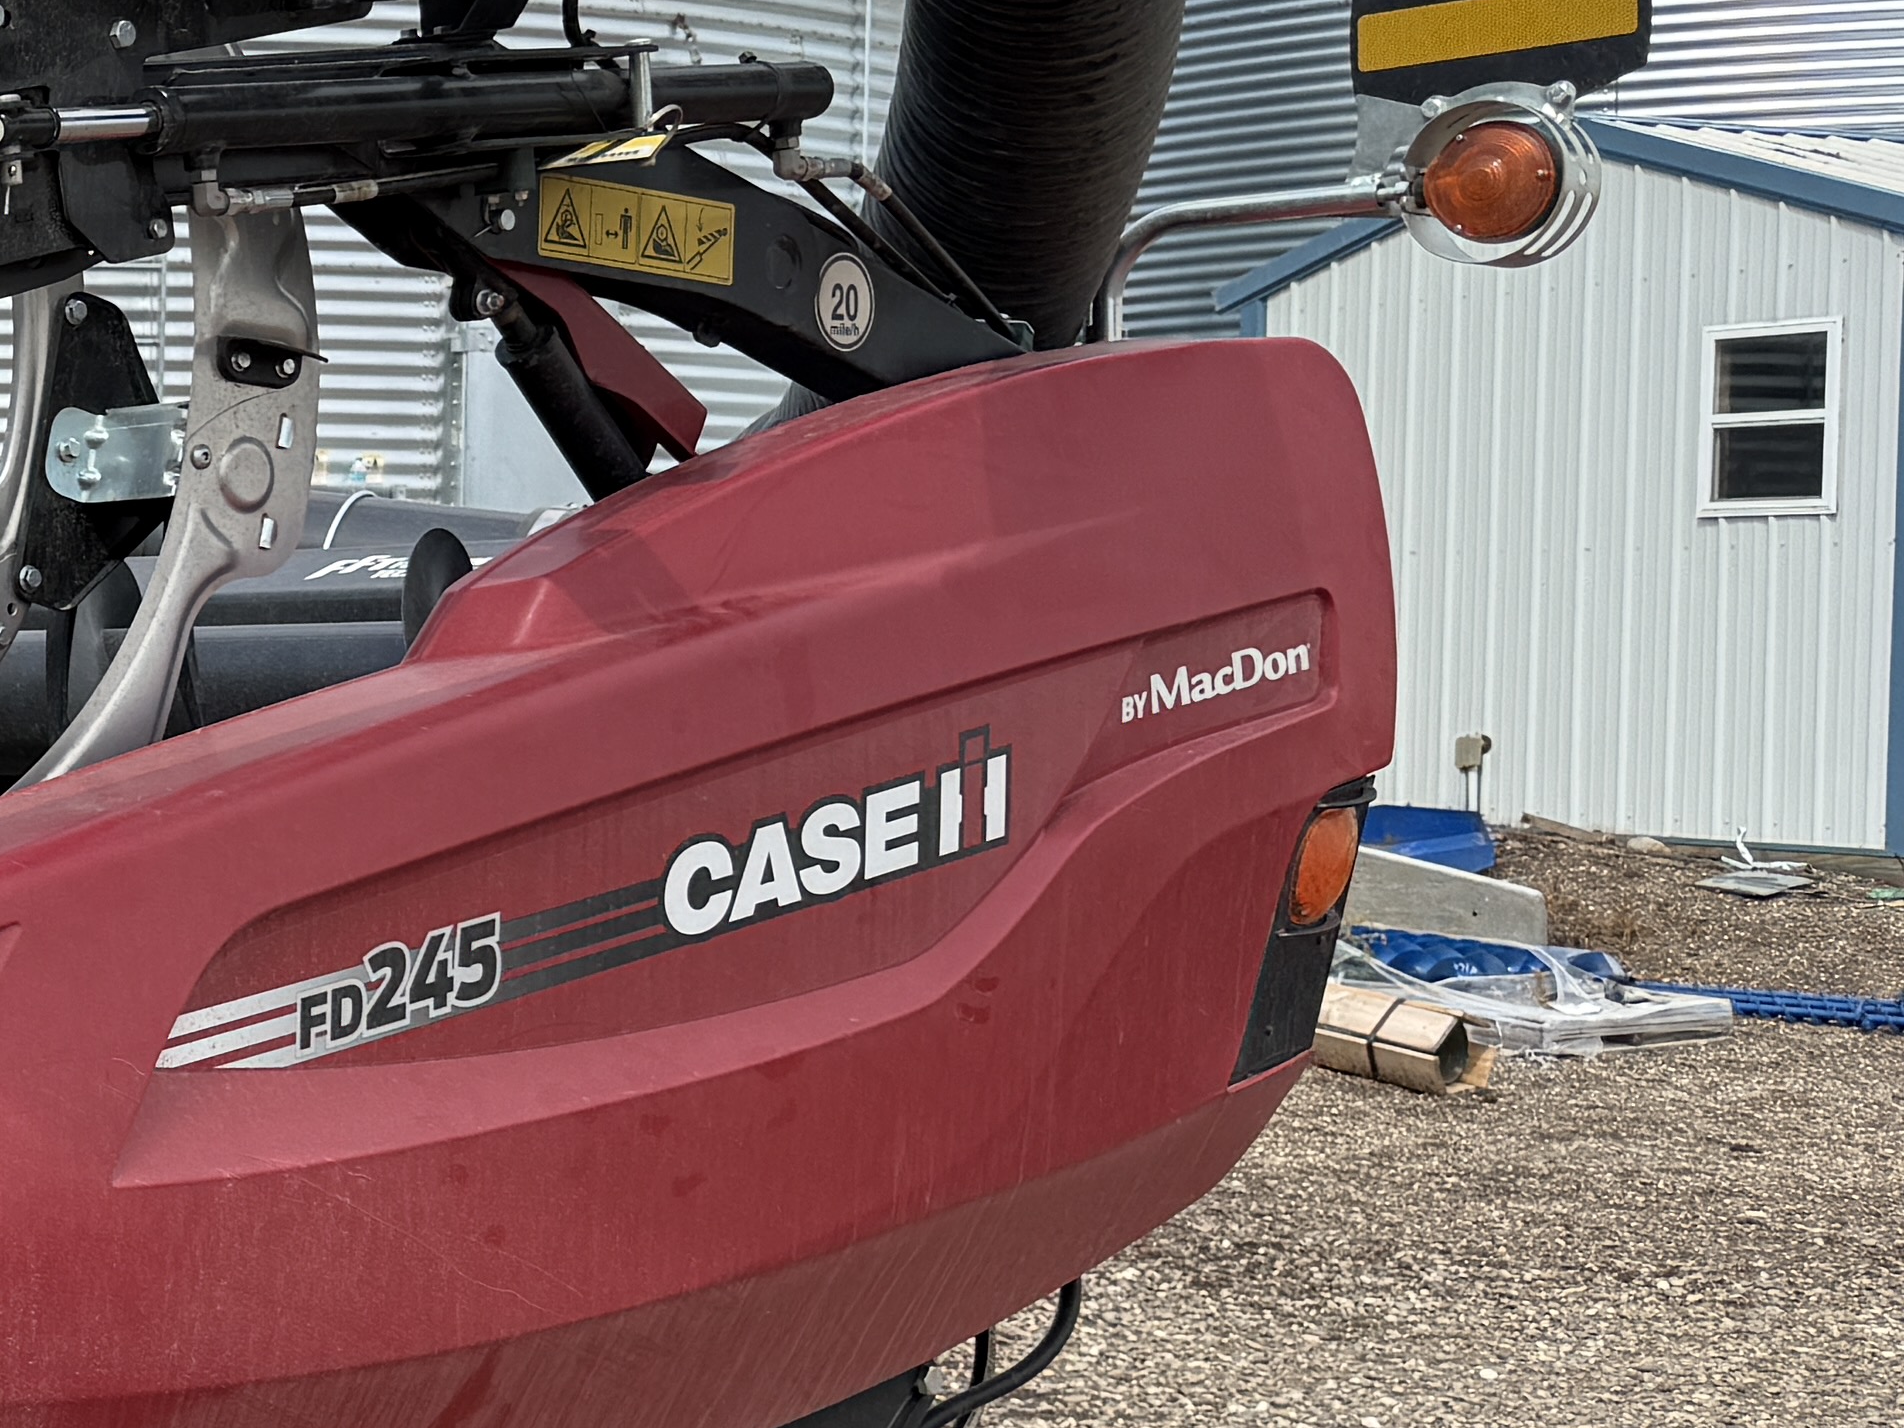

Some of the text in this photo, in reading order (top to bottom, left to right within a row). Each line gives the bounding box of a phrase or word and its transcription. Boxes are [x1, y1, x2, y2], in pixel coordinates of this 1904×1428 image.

[831, 283, 859, 322] 20
[1121, 642, 1311, 724] BY MacDon
[663, 779, 921, 936] CASE
[297, 914, 501, 1053] FD245
